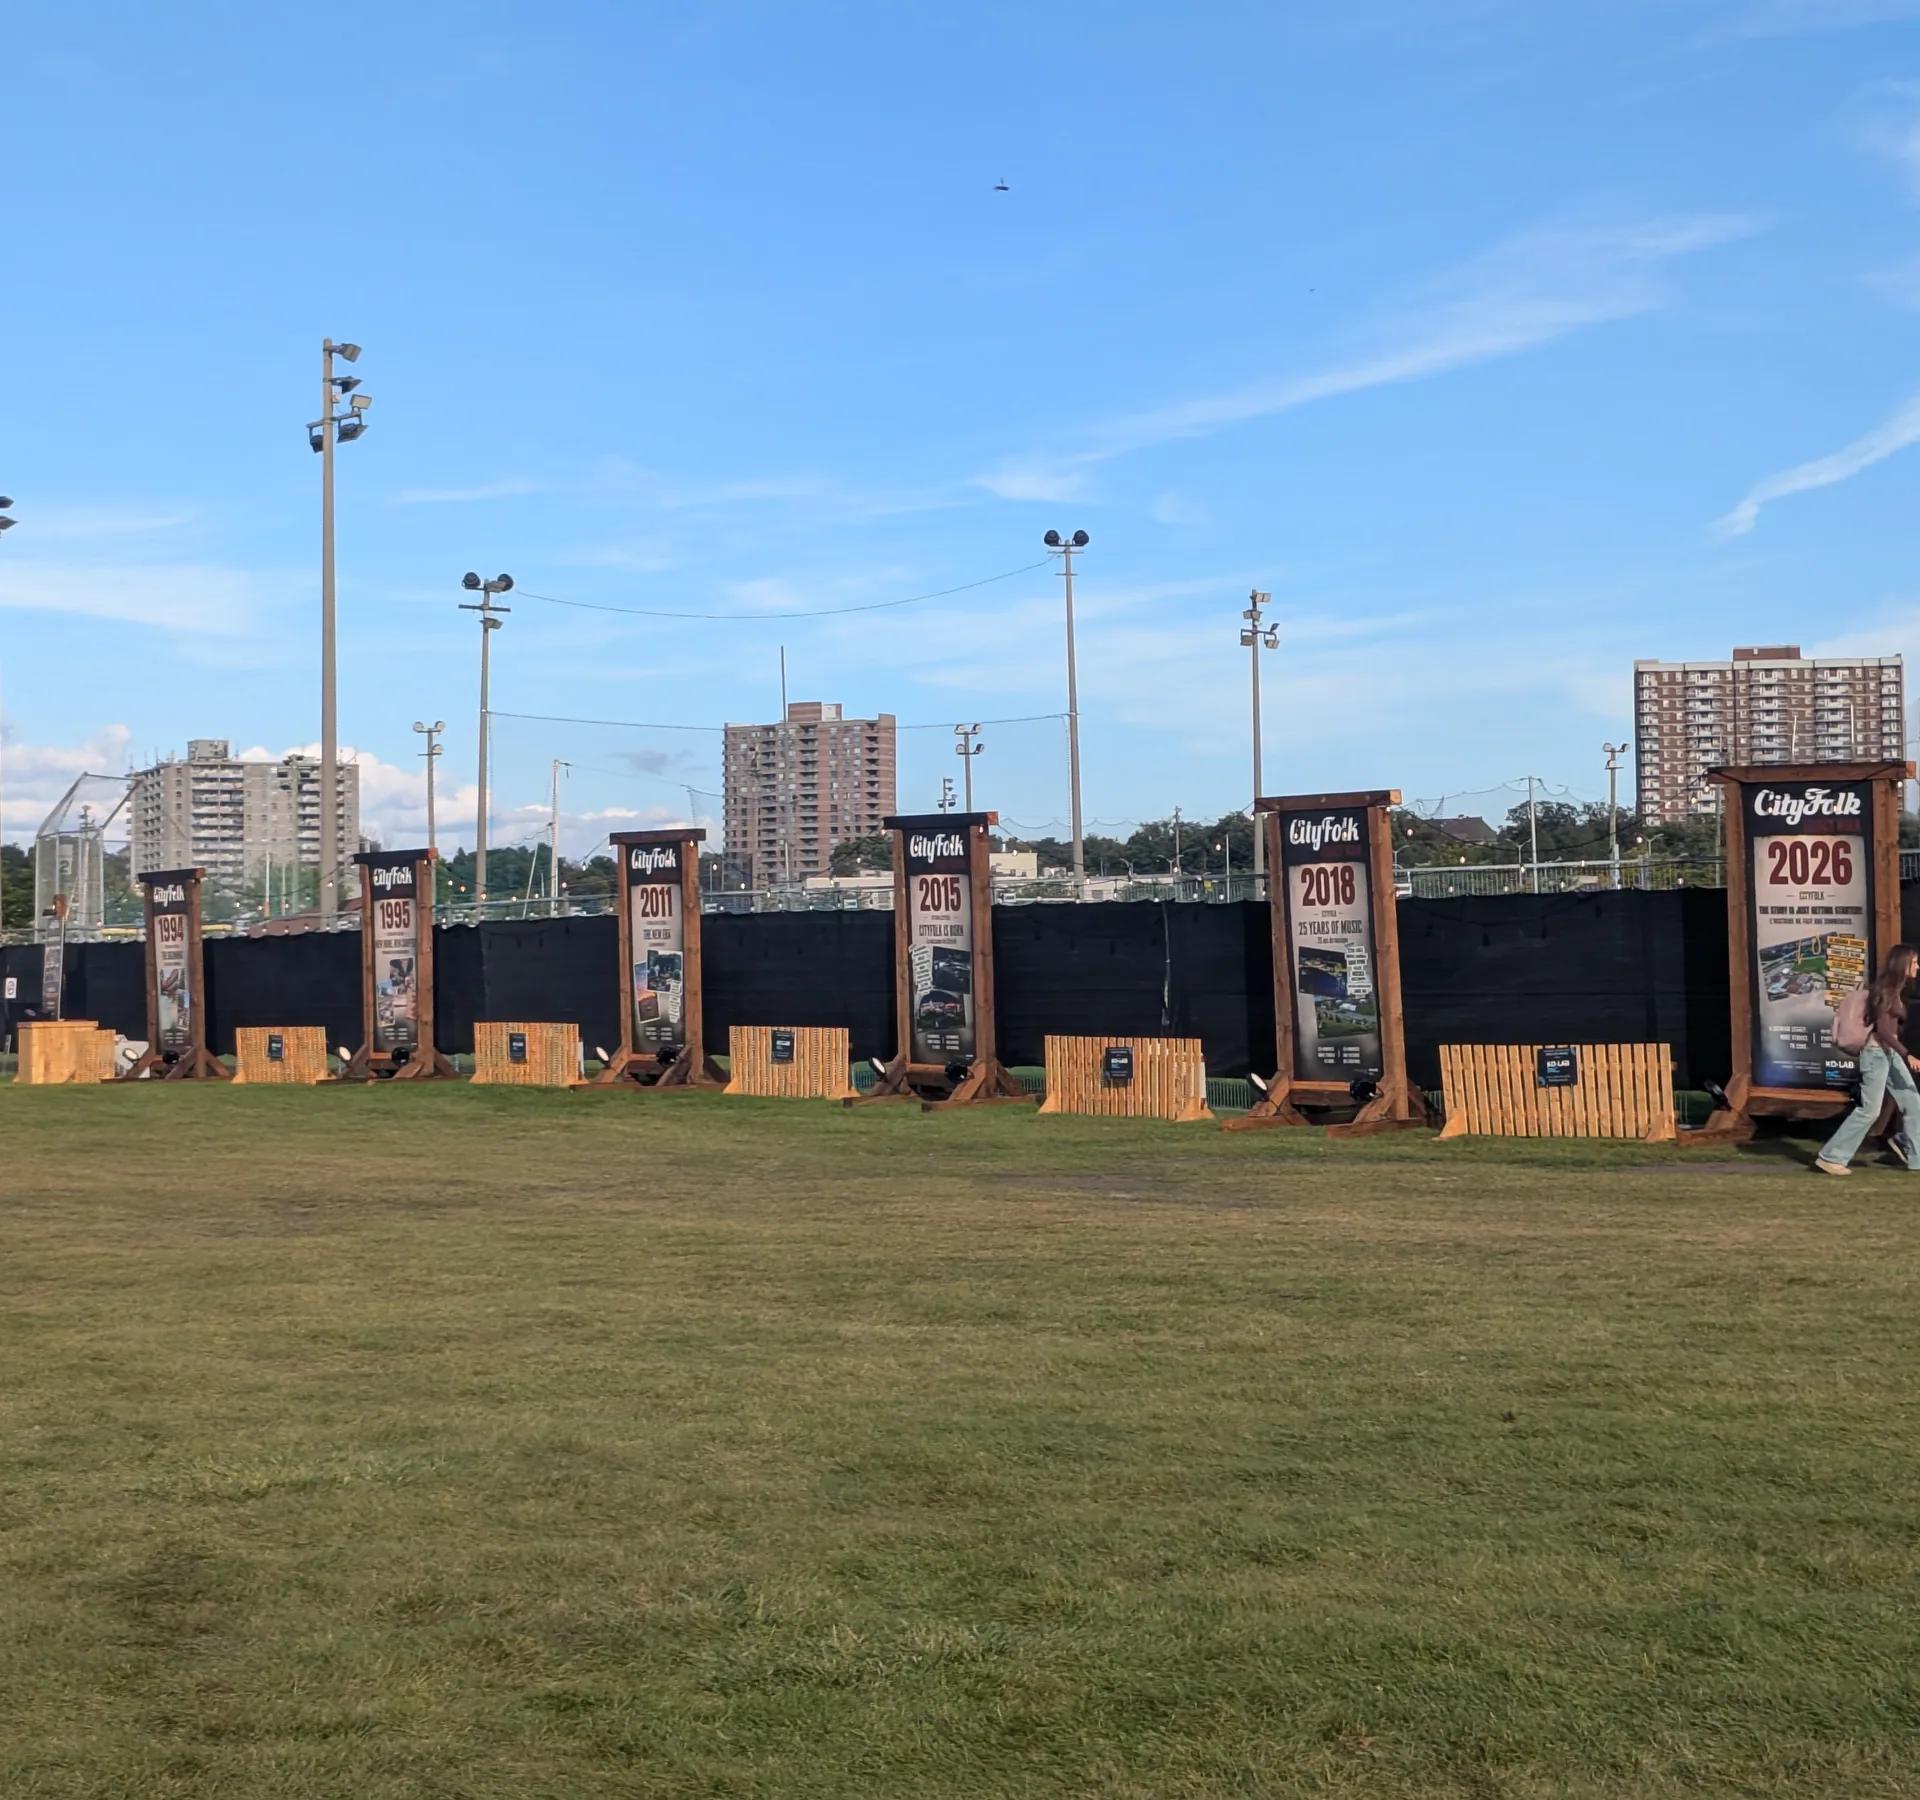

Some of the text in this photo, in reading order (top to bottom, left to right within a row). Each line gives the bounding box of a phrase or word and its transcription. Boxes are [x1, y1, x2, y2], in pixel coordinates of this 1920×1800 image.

[1754, 788, 1861, 825] CityFolk
[910, 834, 965, 863] CityFolk
[1289, 816, 1360, 851] CityFolk
[631, 847, 677, 875] CityFolk
[1768, 840, 1853, 885] 2026
[919, 877, 962, 912] 2015
[1300, 865, 1356, 906] 2018
[380, 901, 410, 929] 1995
[640, 887, 673, 917] 2011
[159, 916, 184, 942] 1994
[1299, 920, 1362, 935] 25 YEARS OF MUSIC
